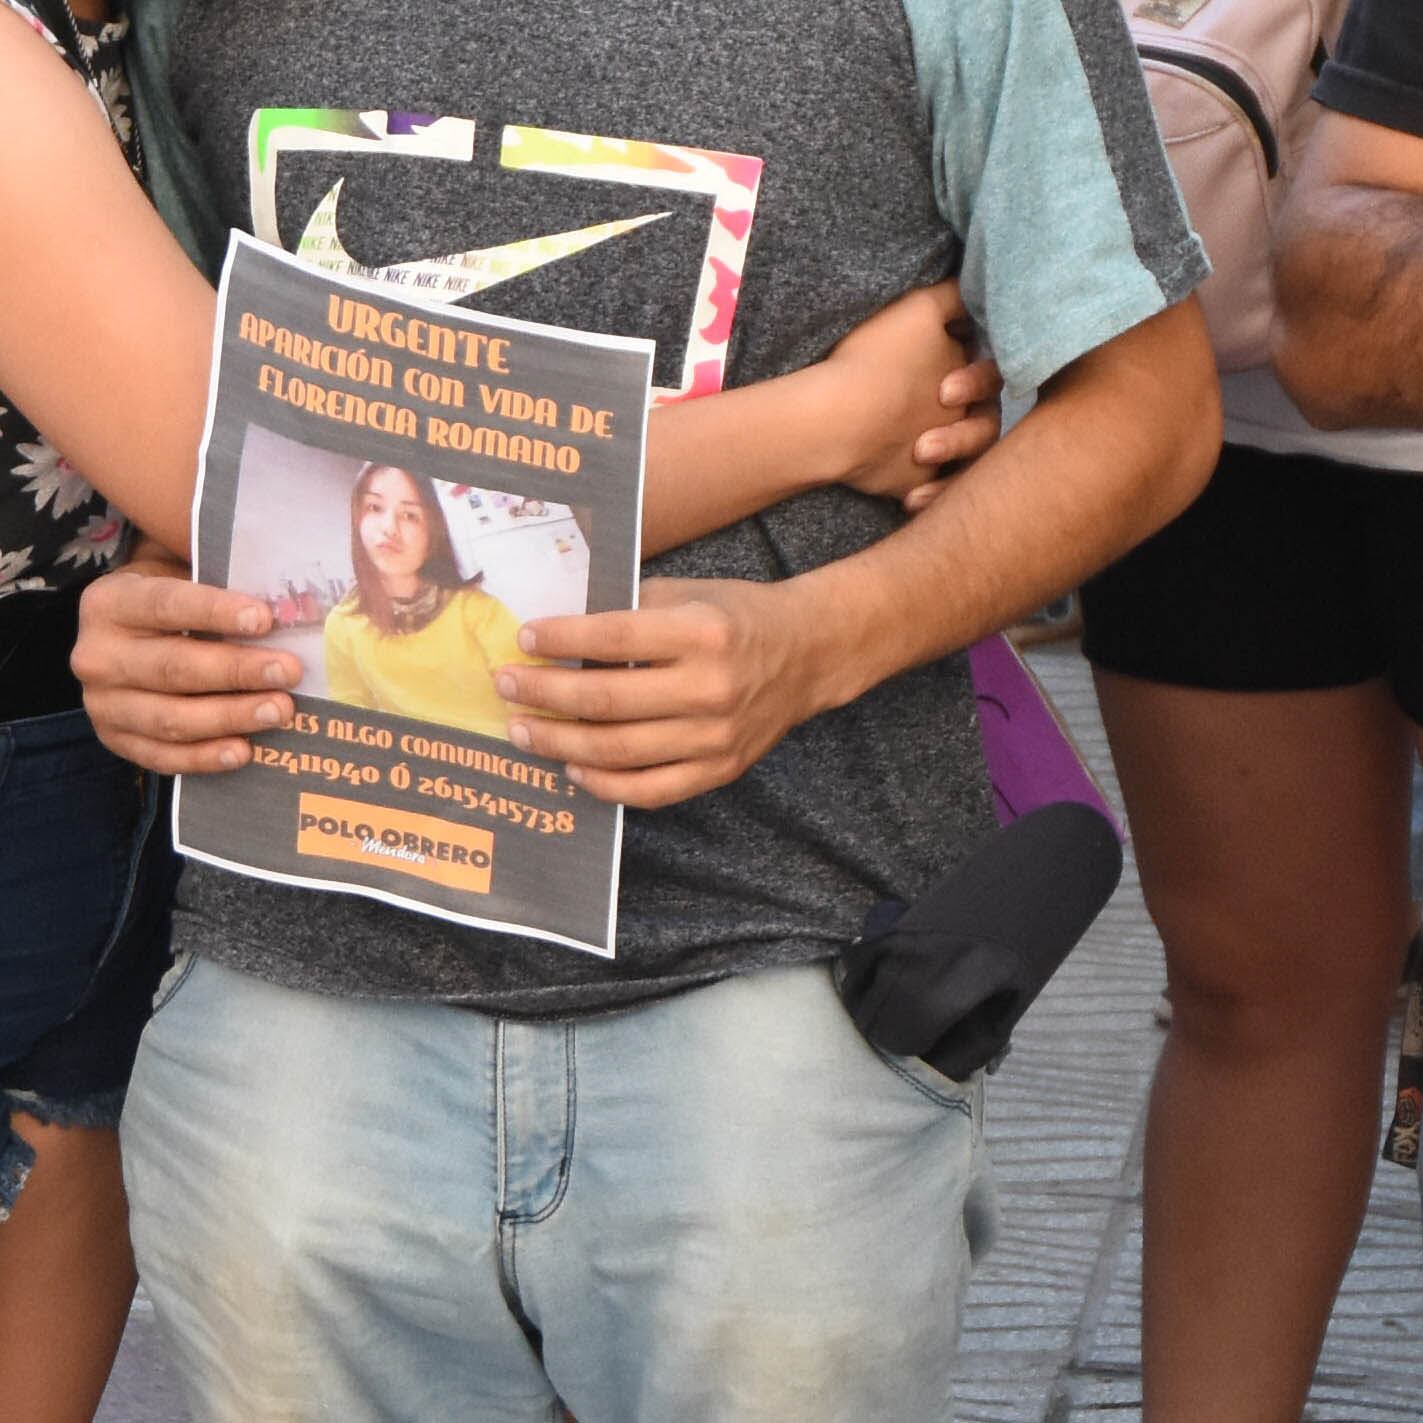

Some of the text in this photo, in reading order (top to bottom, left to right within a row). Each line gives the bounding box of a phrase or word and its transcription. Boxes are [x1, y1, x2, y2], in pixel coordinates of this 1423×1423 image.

[383, 267, 410, 286] NIKE
[412, 271, 440, 290] NIKE
[442, 276, 472, 294] NIKE
[328, 294, 512, 375] URGENTE
[239, 311, 614, 440] APARICIÓN CON VIDA DE
[258, 363, 582, 474] FLORENCIA ROMANO
[326, 718, 394, 750] ALGO
[399, 733, 561, 794] COMUNICATE
[299, 812, 491, 870] POLO OBRERO
[416, 775, 576, 834] 2615415738
